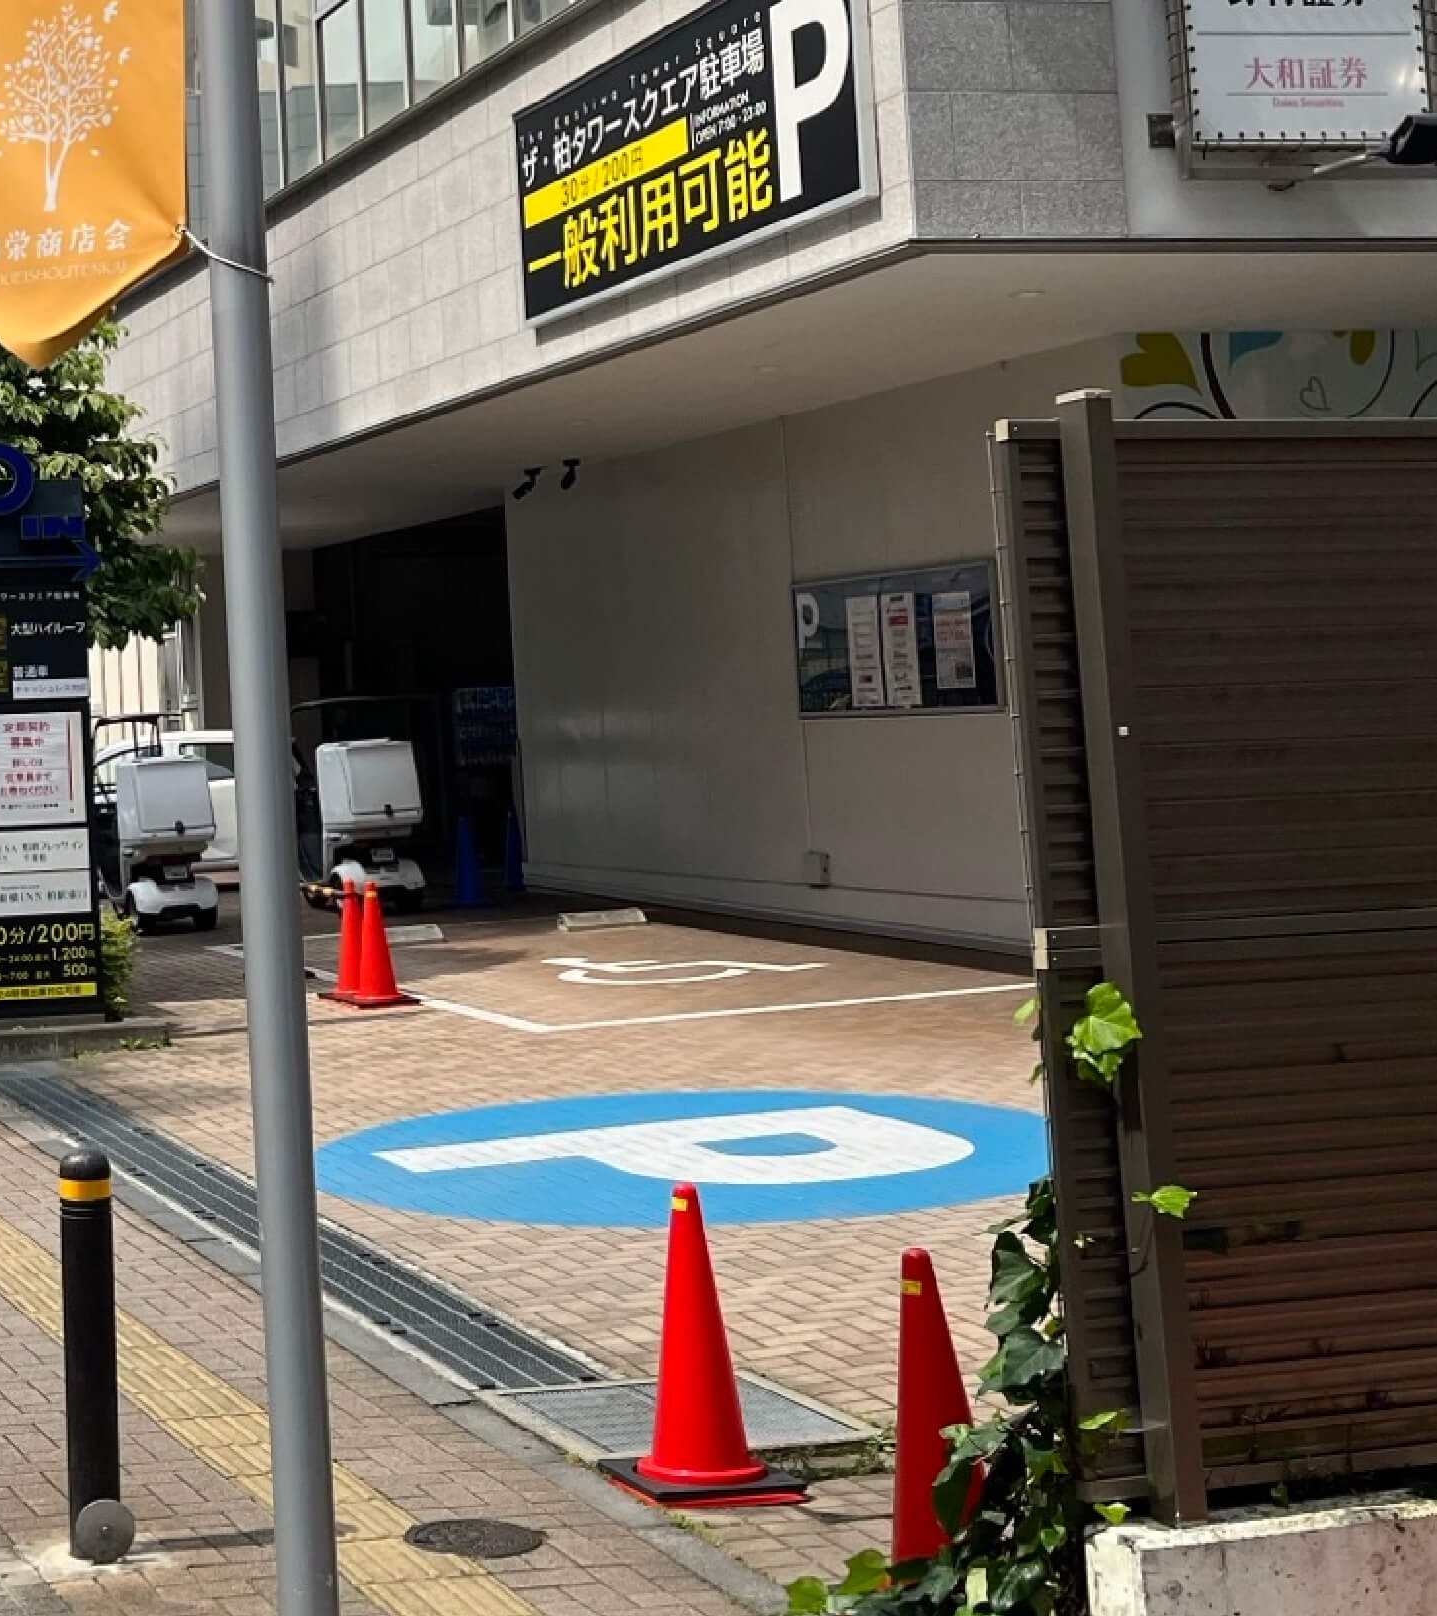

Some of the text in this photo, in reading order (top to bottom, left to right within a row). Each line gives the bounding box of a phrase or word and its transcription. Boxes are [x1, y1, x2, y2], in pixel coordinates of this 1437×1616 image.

[769, 0, 850, 203] P
[1244, 56, 1367, 89] 大和証券
[528, 127, 774, 290] 一般利用可能
